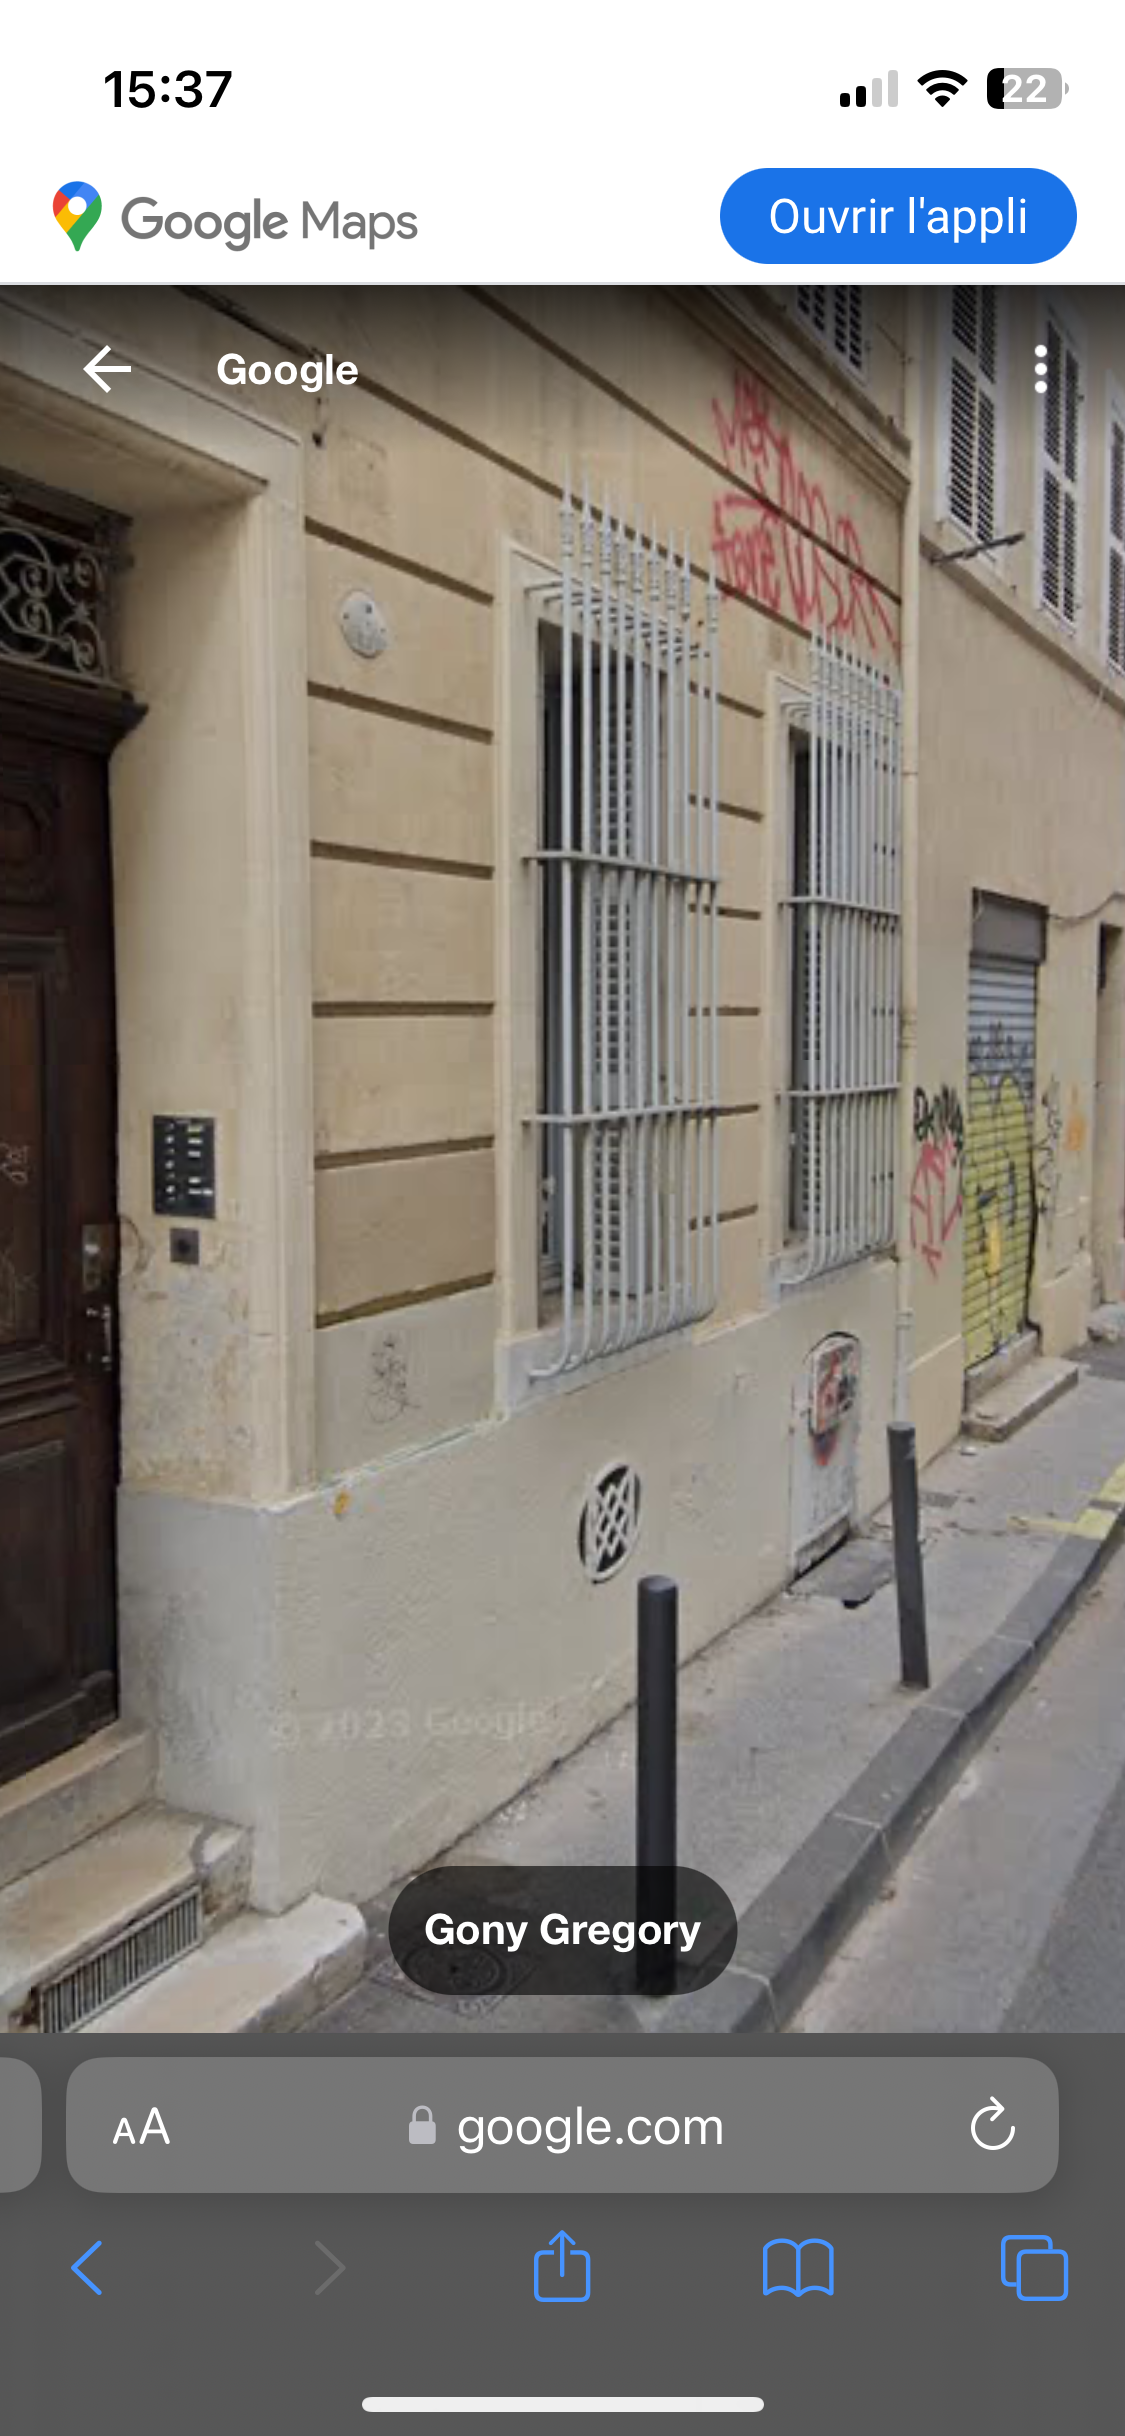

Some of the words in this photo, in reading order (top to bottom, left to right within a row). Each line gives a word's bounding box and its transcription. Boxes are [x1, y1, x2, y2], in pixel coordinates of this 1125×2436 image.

[104, 69, 232, 109] 15:37
[1001, 74, 1047, 103] 22
[121, 196, 289, 252] Google
[302, 200, 418, 250] Maps
[770, 197, 895, 234] Ouvrir
[908, 196, 1027, 244] l'appli
[457, 2106, 723, 2154] google.com
